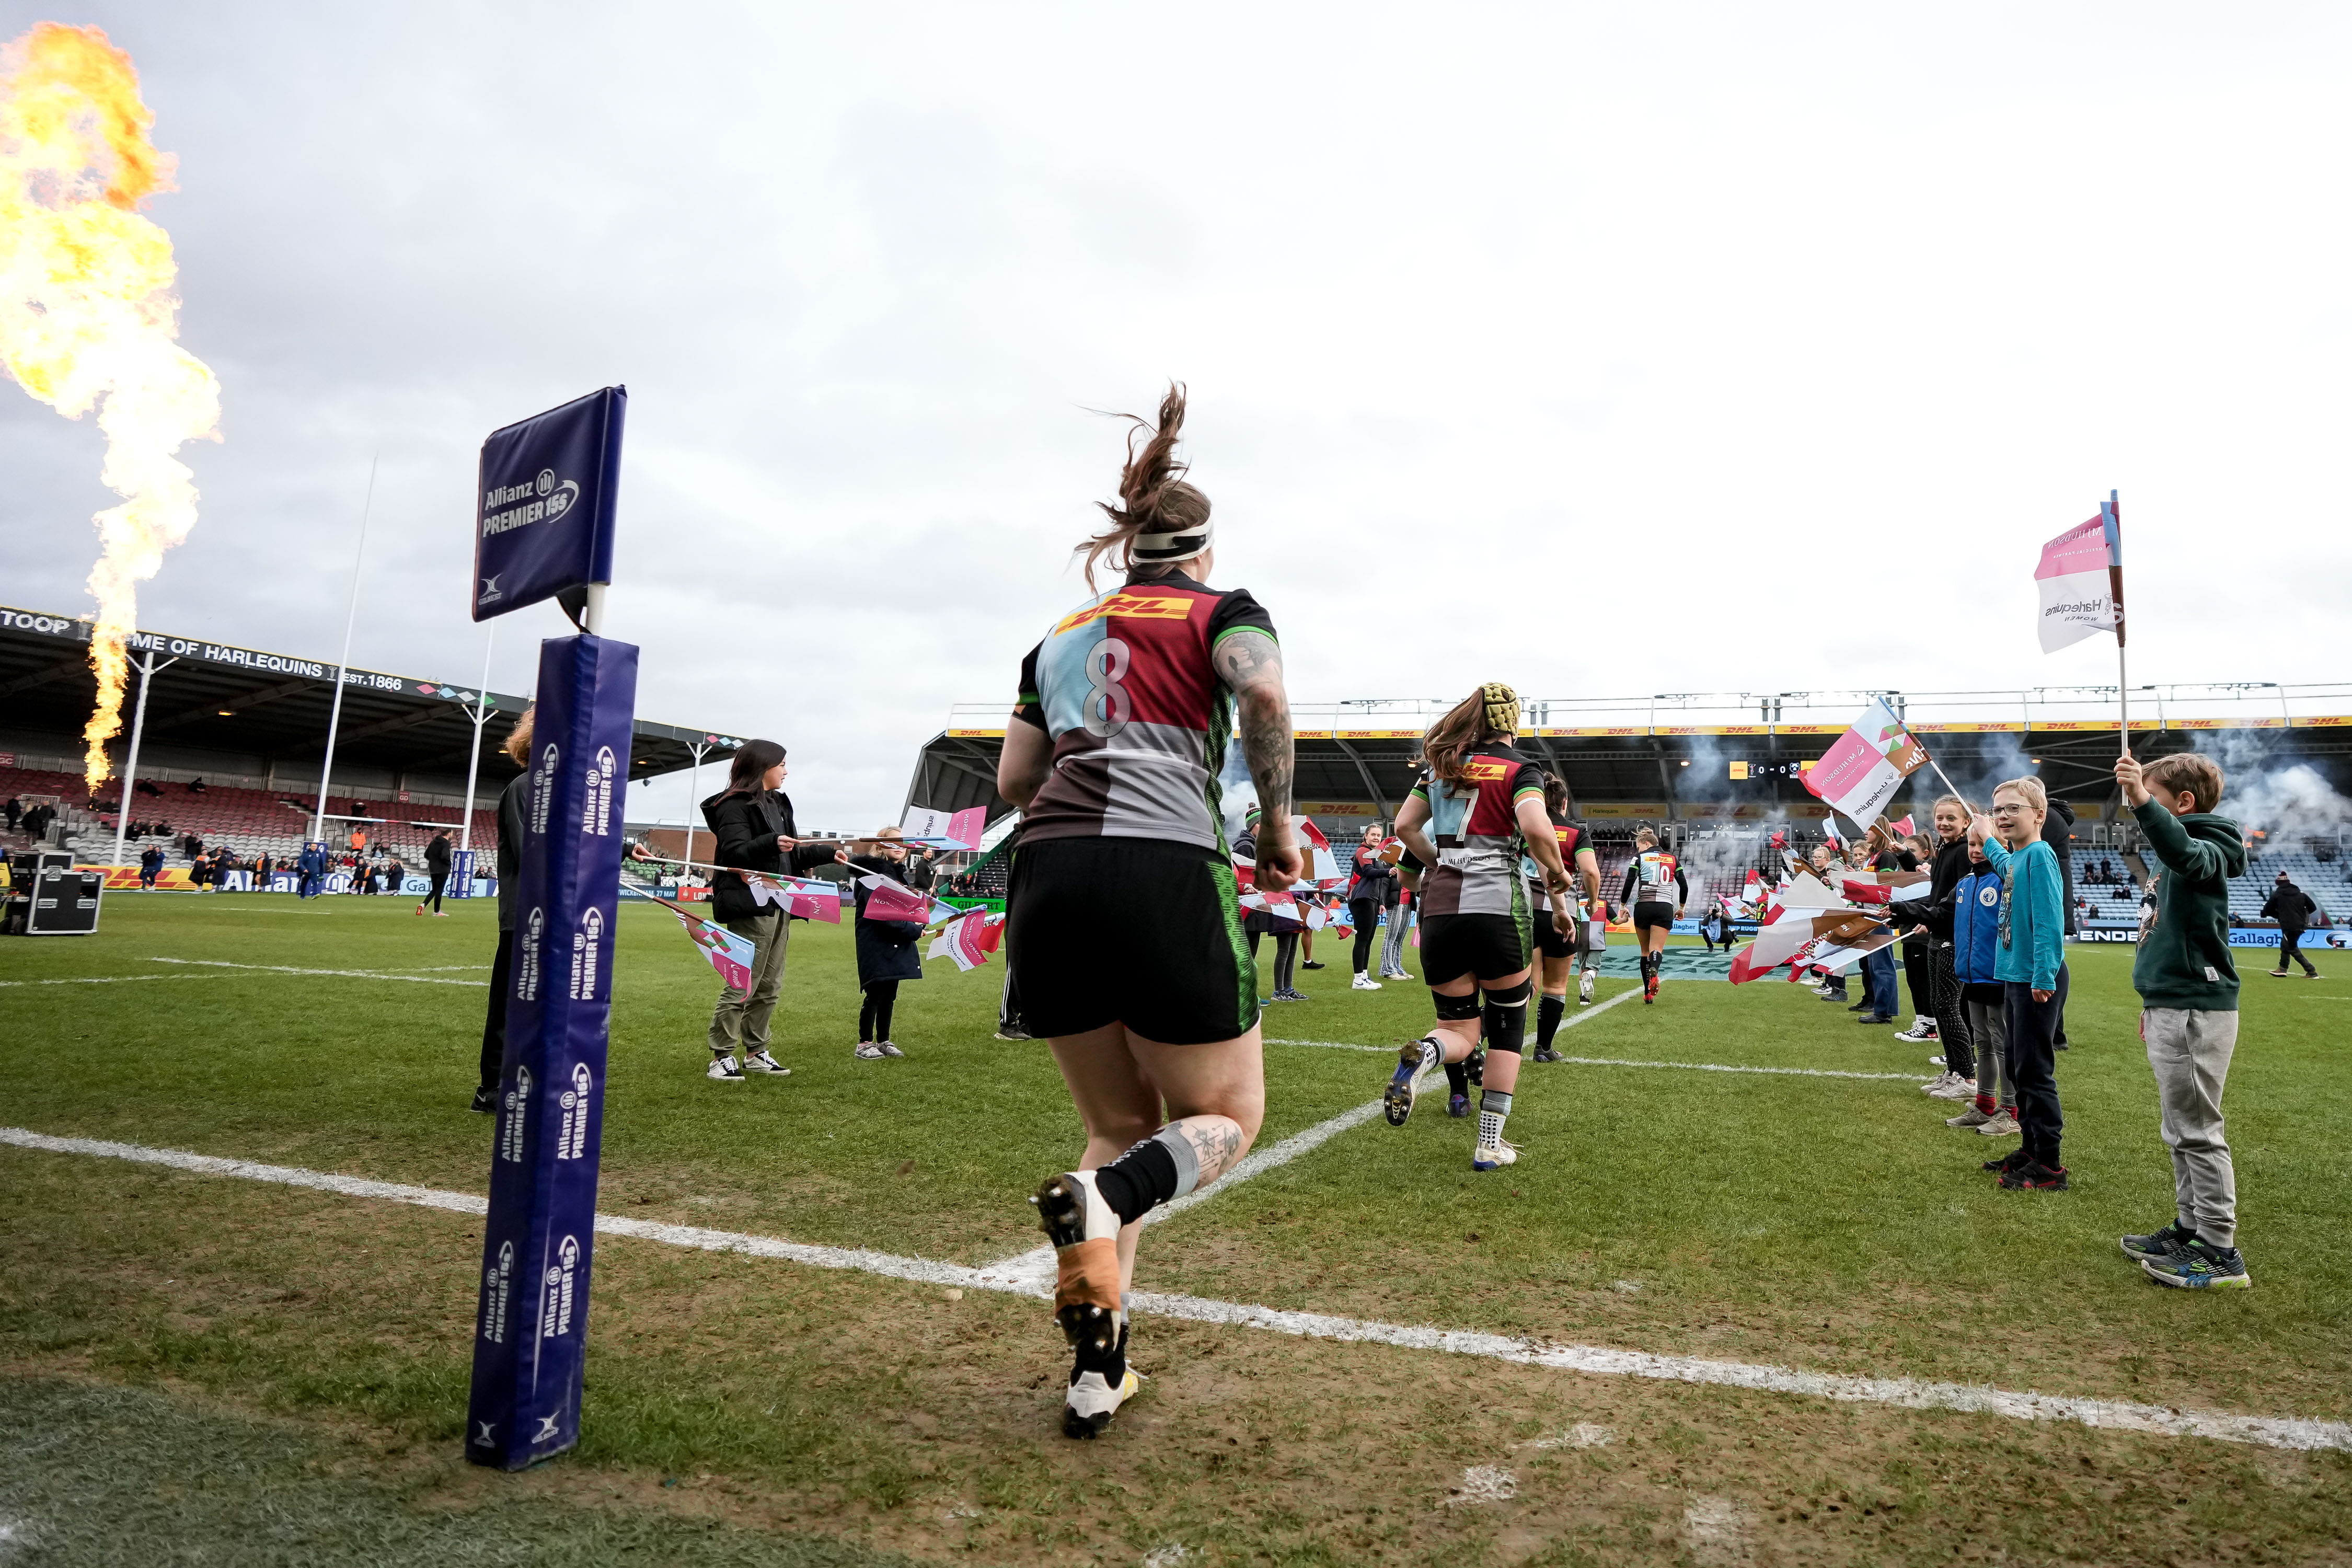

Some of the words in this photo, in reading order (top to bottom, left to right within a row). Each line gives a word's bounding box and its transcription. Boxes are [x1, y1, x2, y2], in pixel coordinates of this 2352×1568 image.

[483, 501, 543, 537] PREMIER
[546, 493, 568, 516] 15s
[485, 482, 533, 511] Allianz
[1067, 597, 1169, 627] DHL
[170, 640, 199, 655] OF
[204, 645, 323, 678] HARLEQUINS
[1083, 638, 1131, 738] 8
[532, 789, 541, 833] Allianz
[538, 777, 552, 834] PREMIER
[583, 789, 597, 834] Allianz
[597, 780, 612, 836] PREMIER
[1320, 805, 1360, 814] DHL
[1454, 788, 1479, 841] 7
[662, 877, 674, 886] GO
[1457, 855, 1491, 864] HUDSON
[1648, 866, 1670, 885] 10
[694, 892, 706, 901] LON
[2079, 930, 2139, 941] ENDE
[2229, 933, 2282, 947] Gallagh
[517, 954, 530, 1000] Allianz
[526, 942, 539, 1001] PREMIER
[570, 953, 582, 999] Allianz
[581, 942, 598, 999] PREMIER
[502, 1113, 514, 1161] Allianz
[513, 1102, 526, 1162] PREMIER
[558, 1112, 573, 1160] Allianz
[572, 1098, 588, 1159] PREMIER
[484, 1290, 496, 1341] Allianz
[494, 1280, 509, 1343] PREMIER
[544, 1287, 559, 1338] Allianz
[558, 1272, 573, 1335] PREMIER
